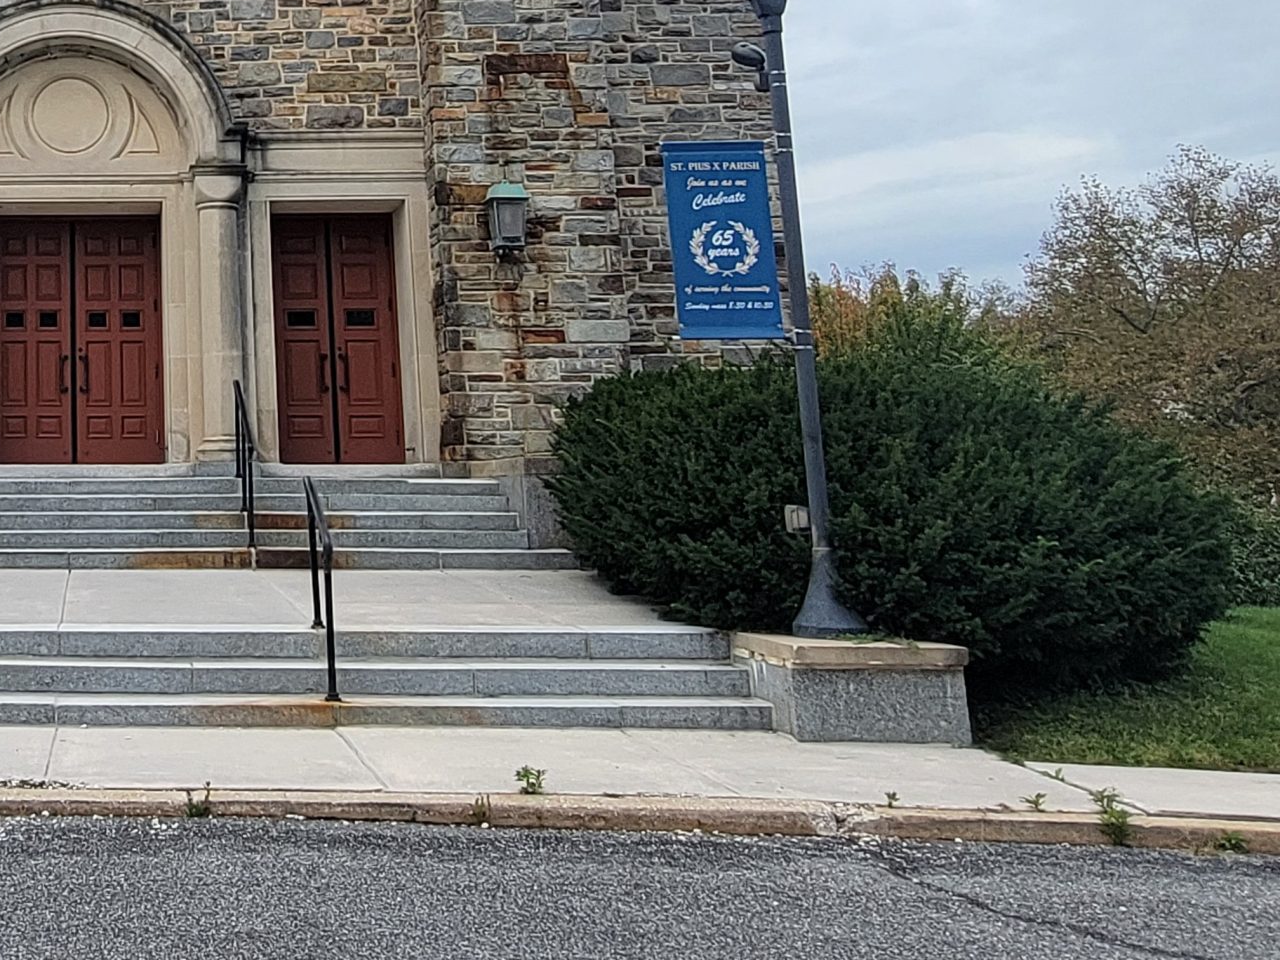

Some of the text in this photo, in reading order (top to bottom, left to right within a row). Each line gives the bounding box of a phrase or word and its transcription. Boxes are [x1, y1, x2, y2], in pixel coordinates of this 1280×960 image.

[688, 162, 711, 171] PIUS
[712, 162, 721, 171] X
[722, 161, 760, 171] PARISH
[686, 176, 706, 190] Join
[692, 191, 746, 210] Celebrate
[711, 230, 735, 246] 65
[707, 247, 740, 260] years
[720, 283, 732, 292] the
